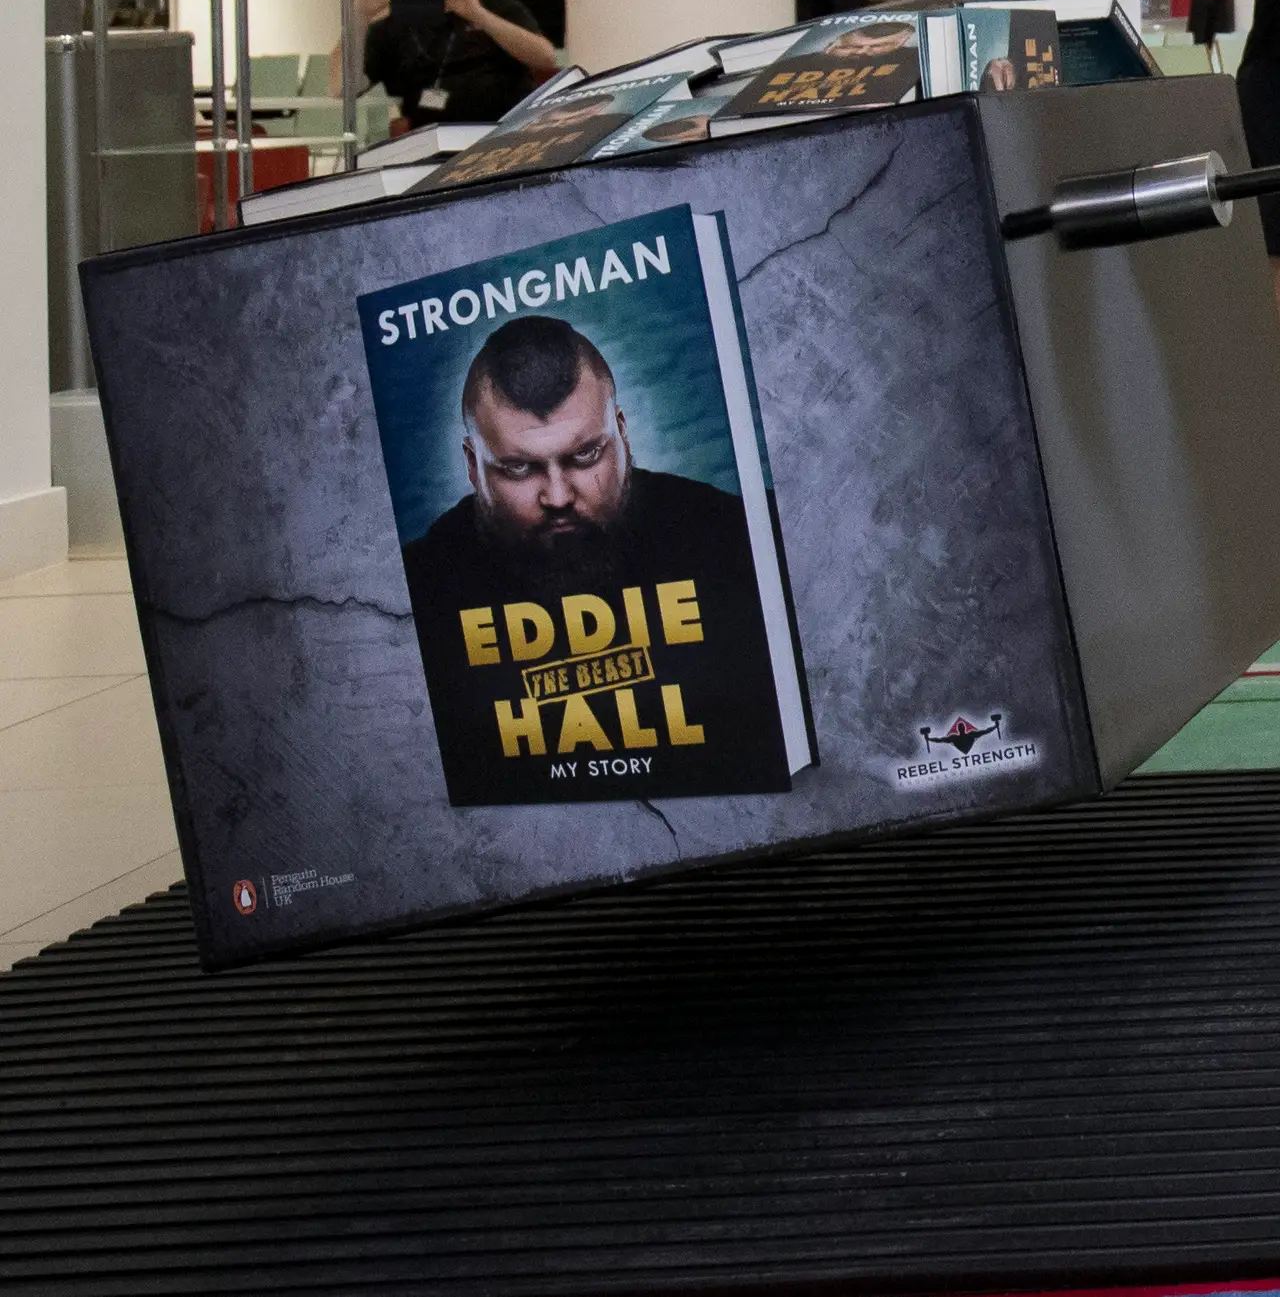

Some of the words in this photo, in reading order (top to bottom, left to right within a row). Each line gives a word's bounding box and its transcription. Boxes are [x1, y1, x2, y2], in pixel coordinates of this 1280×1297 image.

[820, 13, 918, 27] STRONG
[768, 64, 900, 87] EDDIE
[758, 82, 868, 104] HALL
[591, 103, 677, 161] TRONGMAN
[378, 235, 671, 345] STRONGMAN
[459, 579, 704, 667] EDDIE
[531, 664, 570, 697] THE
[575, 651, 645, 689] BEAST
[494, 684, 706, 758] HALL
[551, 762, 577, 779] MY
[588, 757, 652, 777] STORY
[897, 760, 948, 780] REBEL
[952, 743, 1036, 770] STRENGTH
[271, 868, 318, 886] Penguin
[273, 880, 319, 897] Random
[320, 872, 355, 887] House
[274, 893, 293, 907] UK
